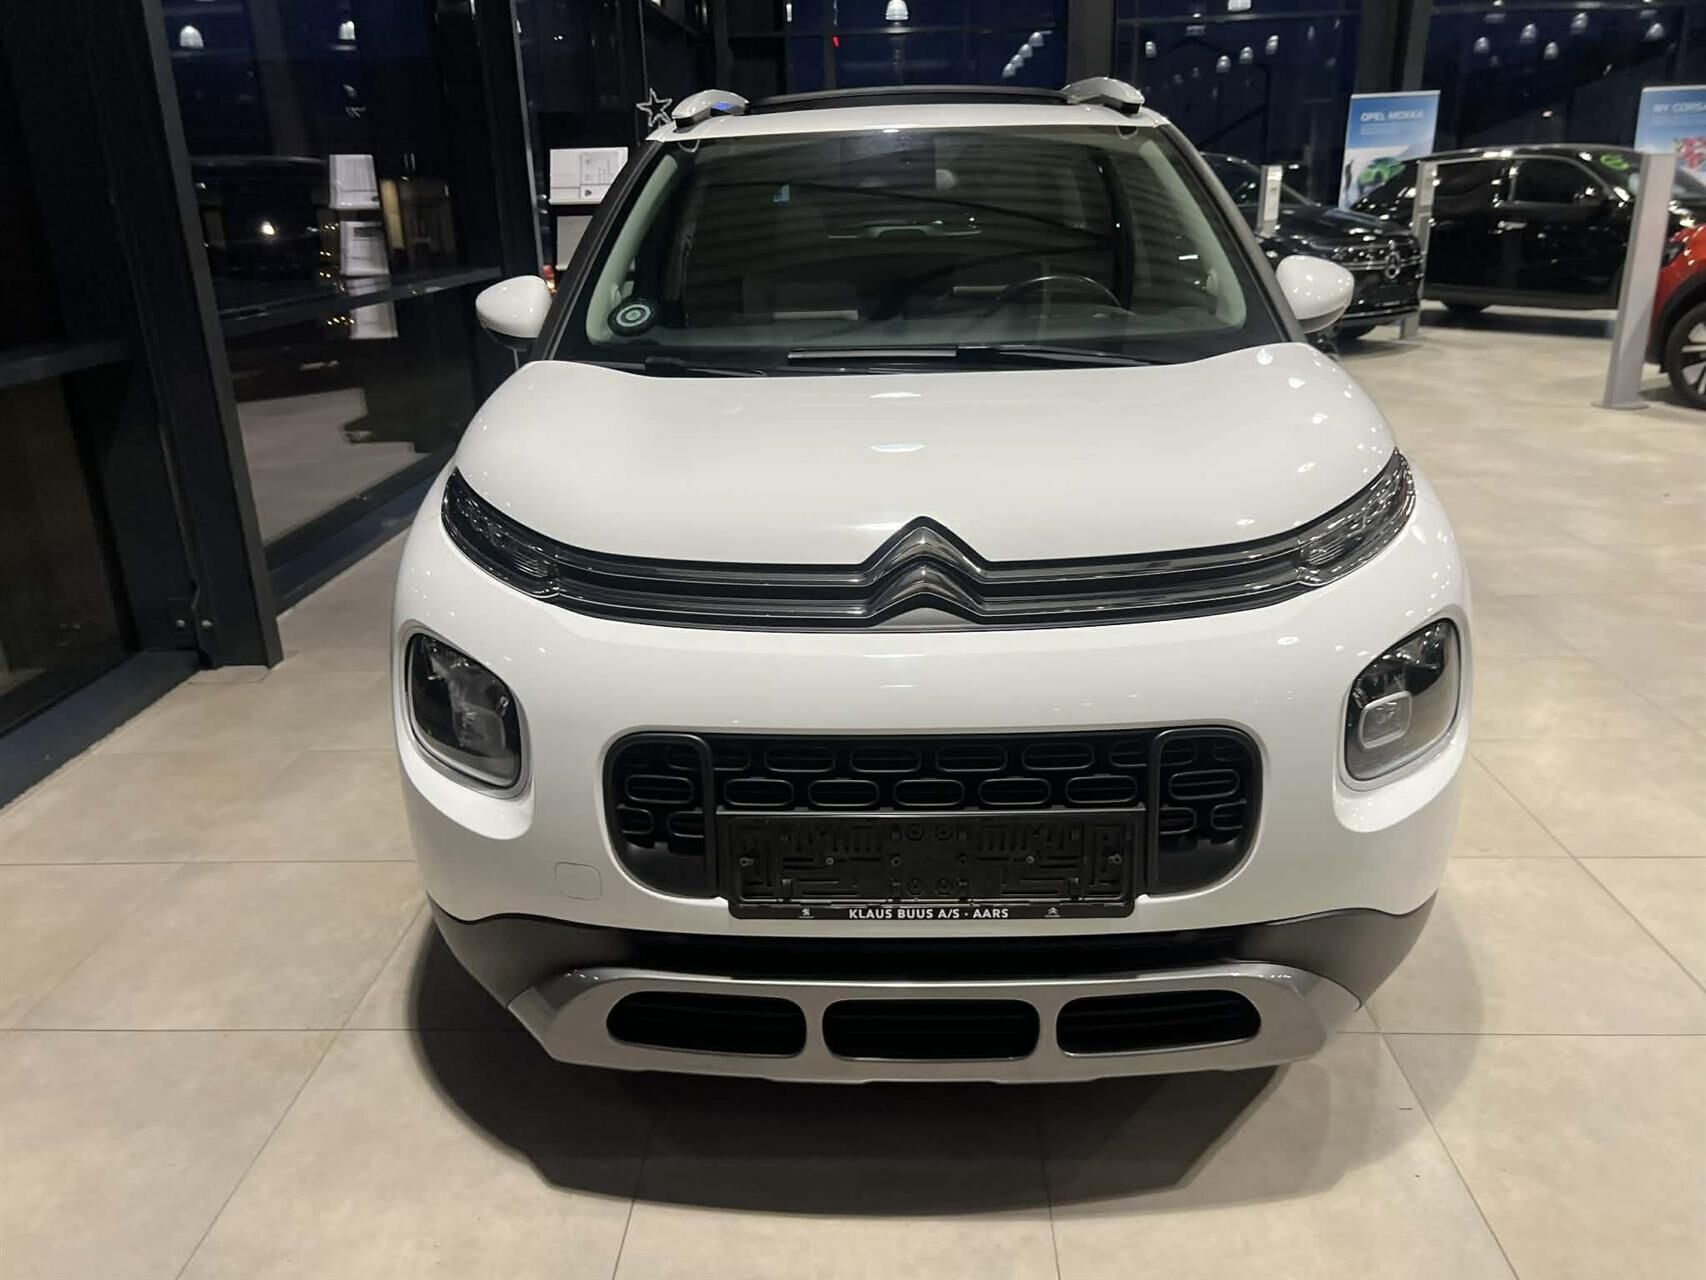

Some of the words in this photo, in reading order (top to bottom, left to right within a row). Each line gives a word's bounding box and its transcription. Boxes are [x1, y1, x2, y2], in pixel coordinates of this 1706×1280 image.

[1360, 111, 1386, 121] OPEL
[849, 908, 893, 919] KLAUS
[897, 908, 934, 919] BUUS
[937, 908, 960, 919] A/S
[972, 908, 1009, 919] AARS
